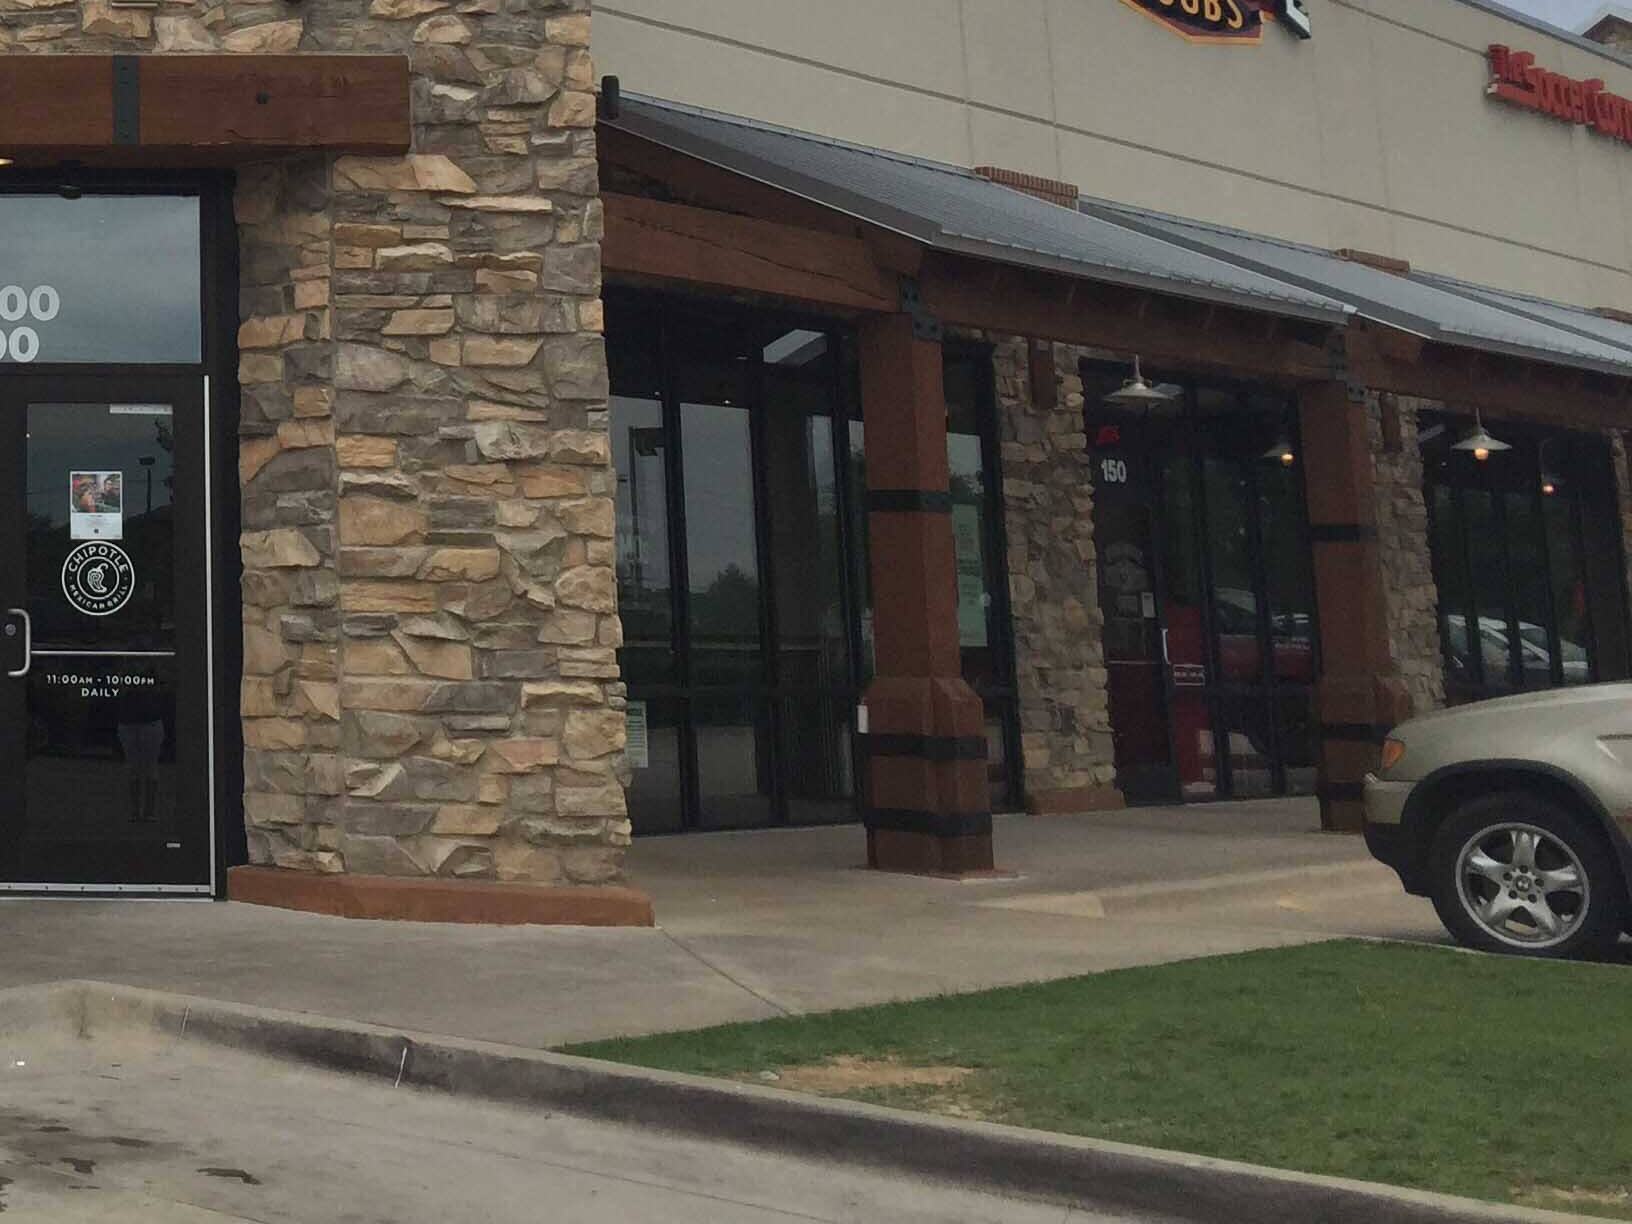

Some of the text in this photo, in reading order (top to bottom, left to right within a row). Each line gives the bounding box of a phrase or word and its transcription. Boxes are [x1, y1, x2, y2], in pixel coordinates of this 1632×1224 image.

[1100, 458, 1127, 483] 150
[68, 545, 129, 574] CHIPOTLE
[81, 687, 120, 697] DAILY
